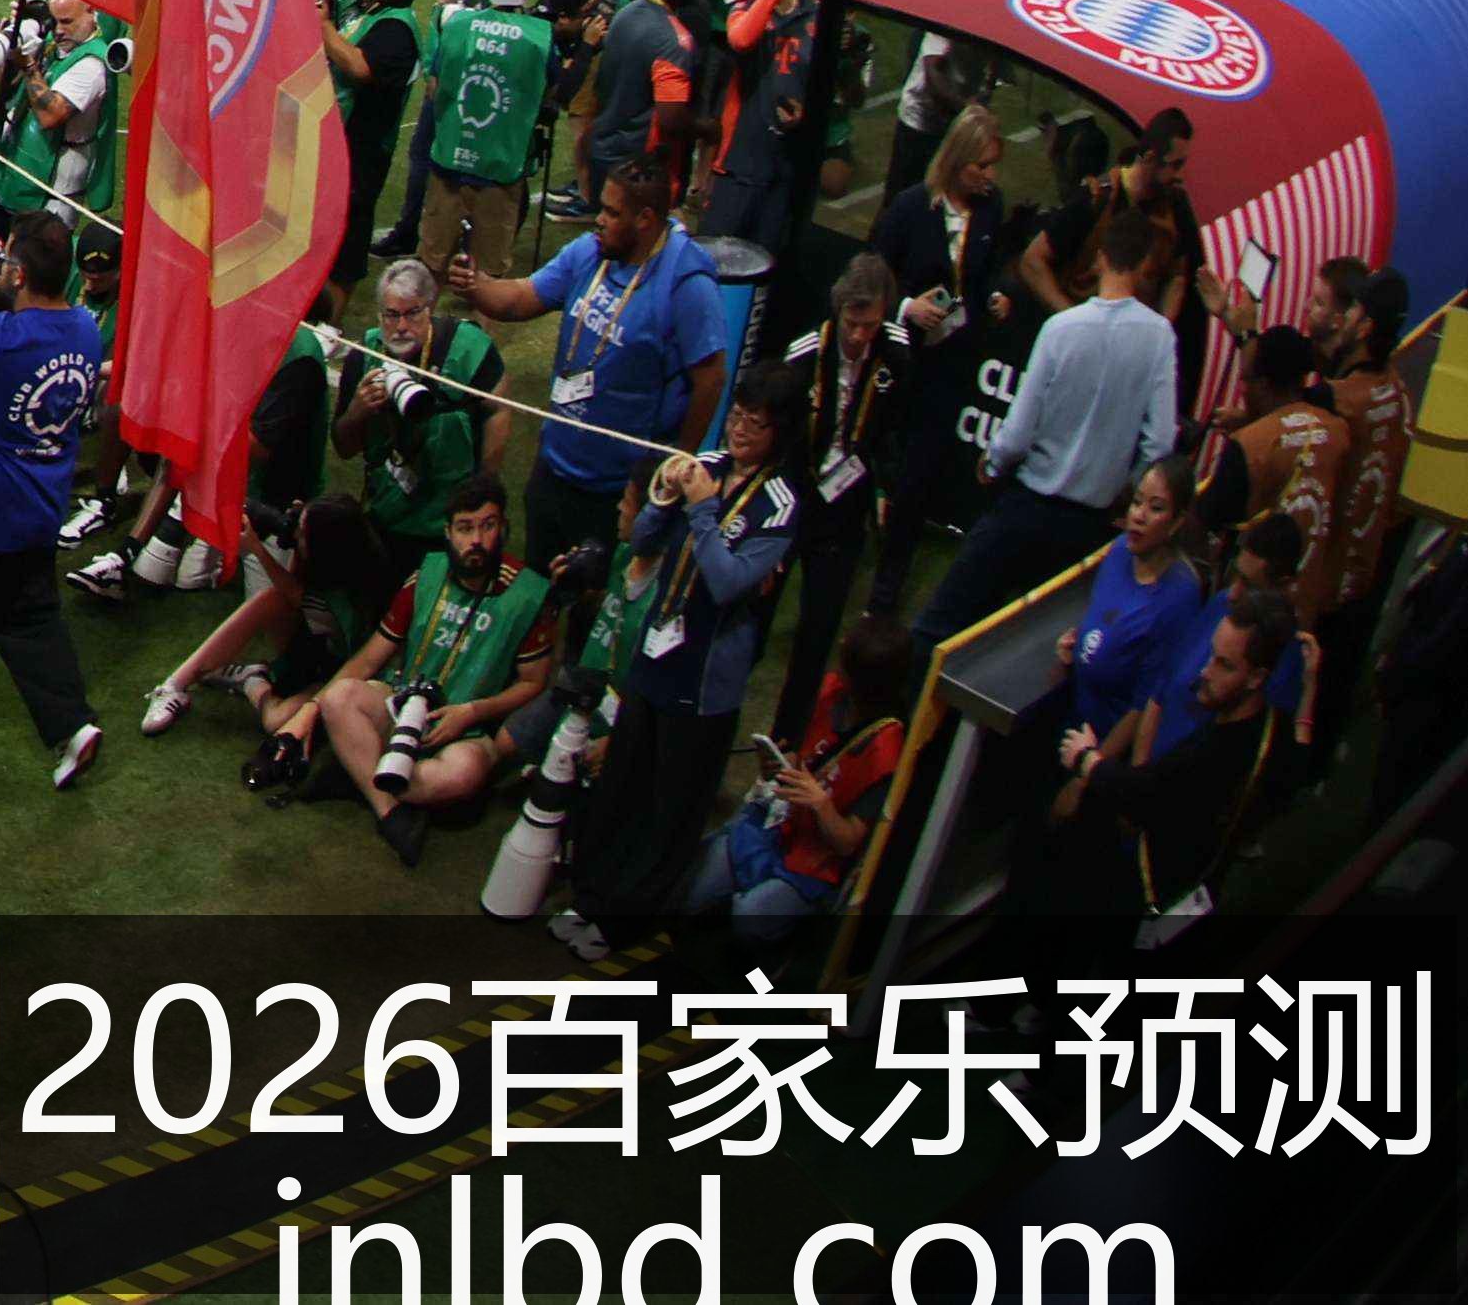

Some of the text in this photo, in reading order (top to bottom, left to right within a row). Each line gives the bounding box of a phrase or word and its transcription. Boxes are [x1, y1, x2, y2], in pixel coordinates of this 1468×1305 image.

[470, 19, 523, 41] PHOTO
[1029, 2, 1073, 37] FC
[475, 38, 508, 57] 064
[1117, 13, 1260, 87] MÜNCHEN
[8, 382, 32, 422] CLUB
[34, 352, 84, 379] WORLD
